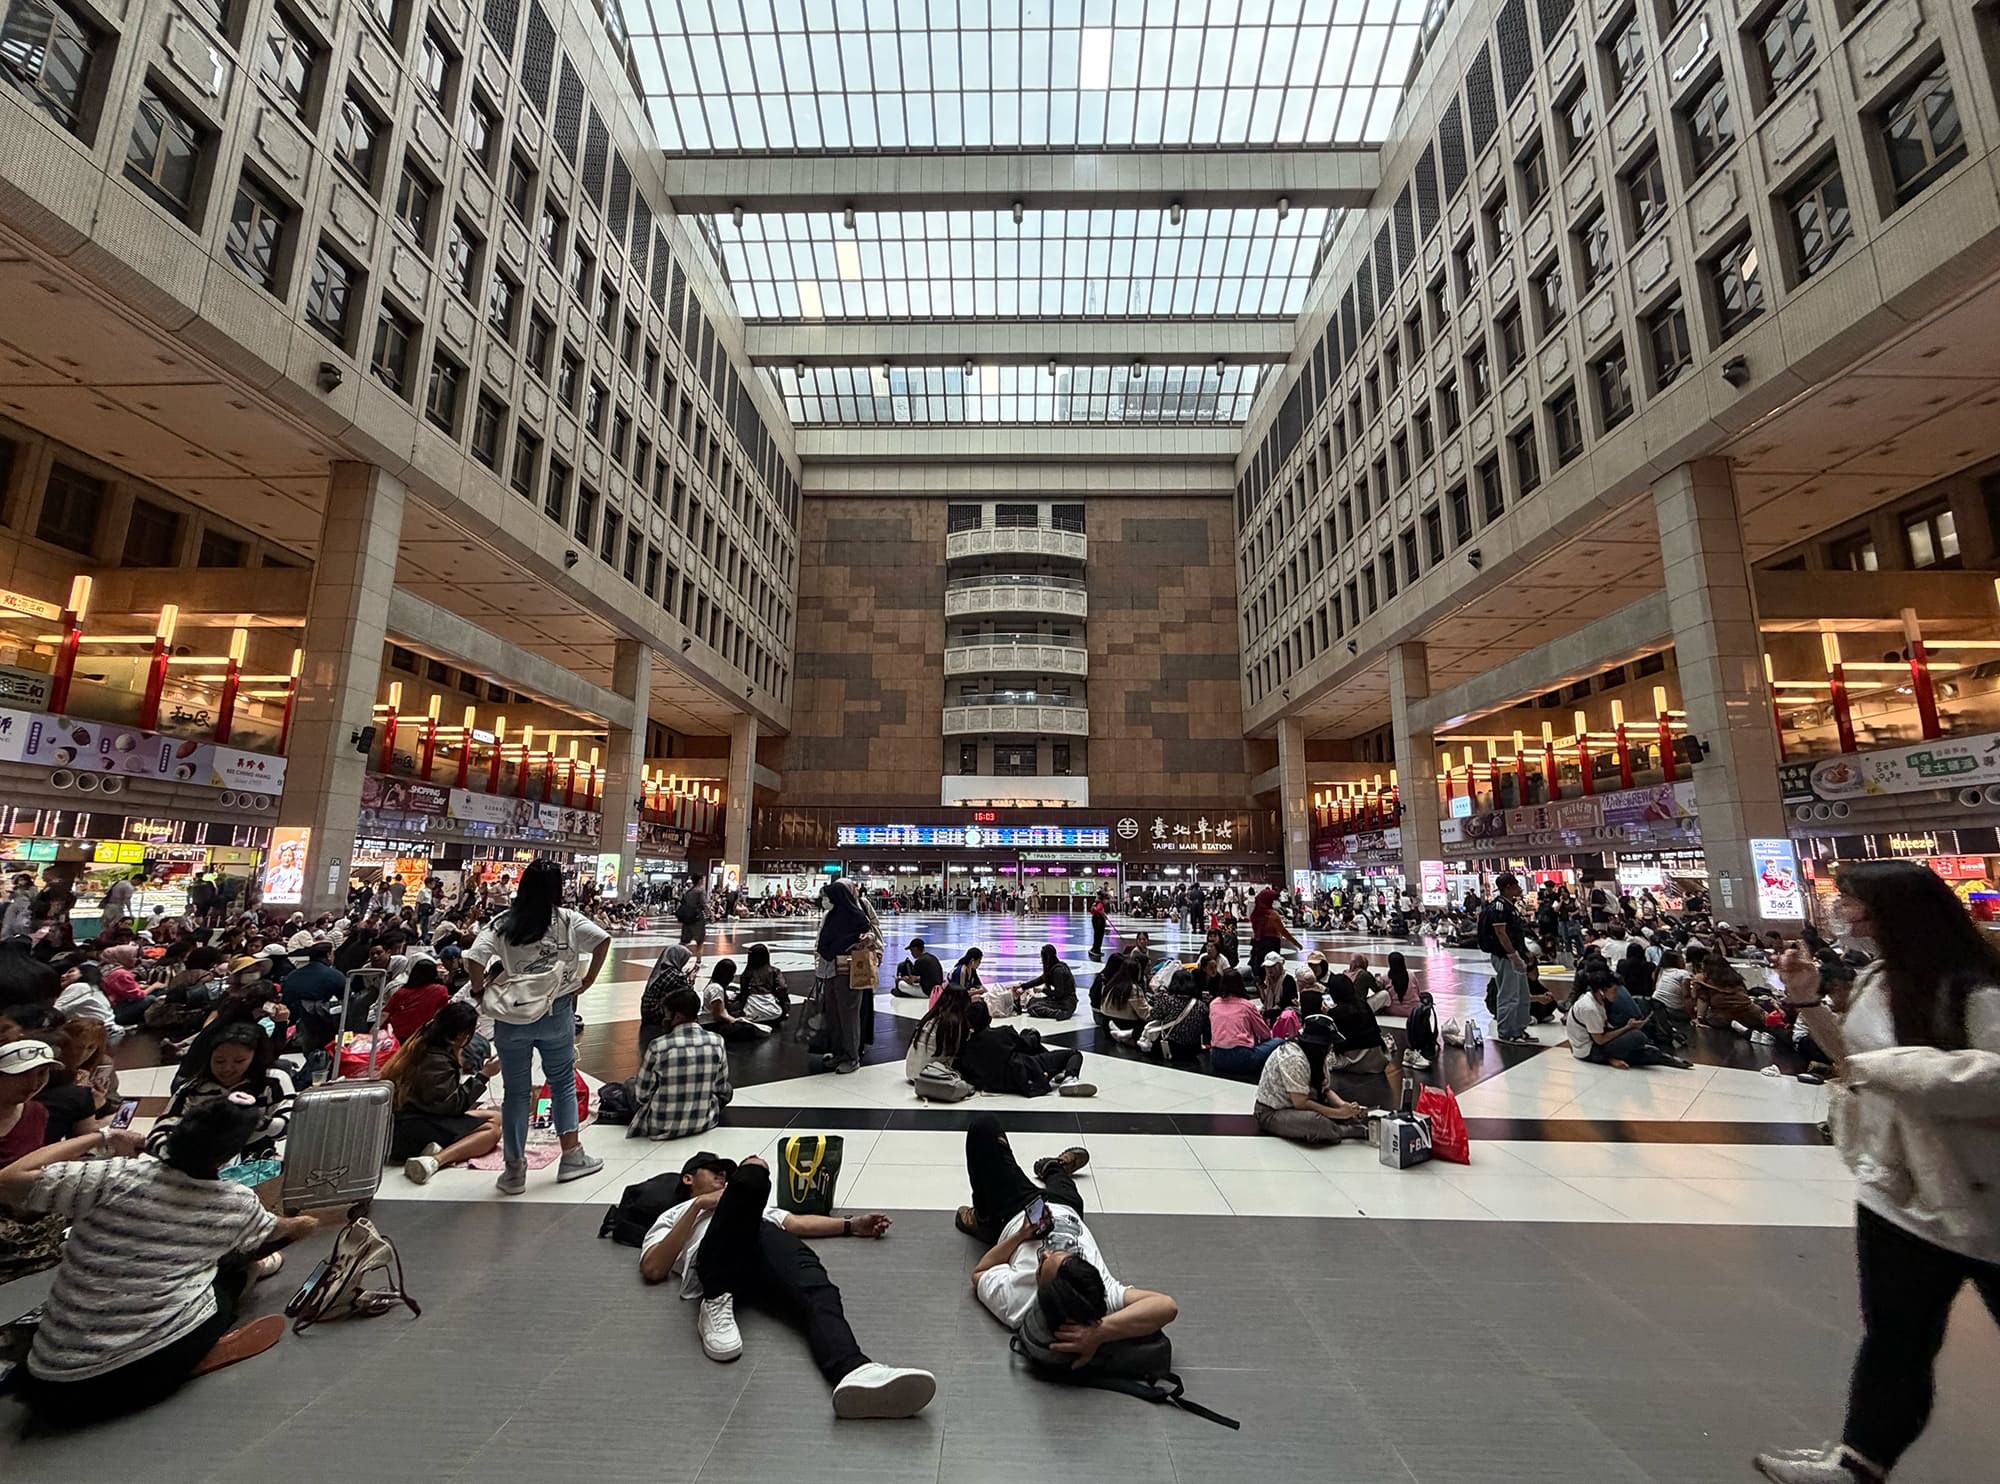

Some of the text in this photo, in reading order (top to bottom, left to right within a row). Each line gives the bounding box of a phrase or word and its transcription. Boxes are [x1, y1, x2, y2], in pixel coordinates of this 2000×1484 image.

[14, 682, 44, 699] 三和
[409, 785, 441, 797] SHOPPING
[133, 823, 173, 835] Breeze
[1149, 816, 1232, 841] 臺北車站
[1892, 838, 1935, 850] Breeze
